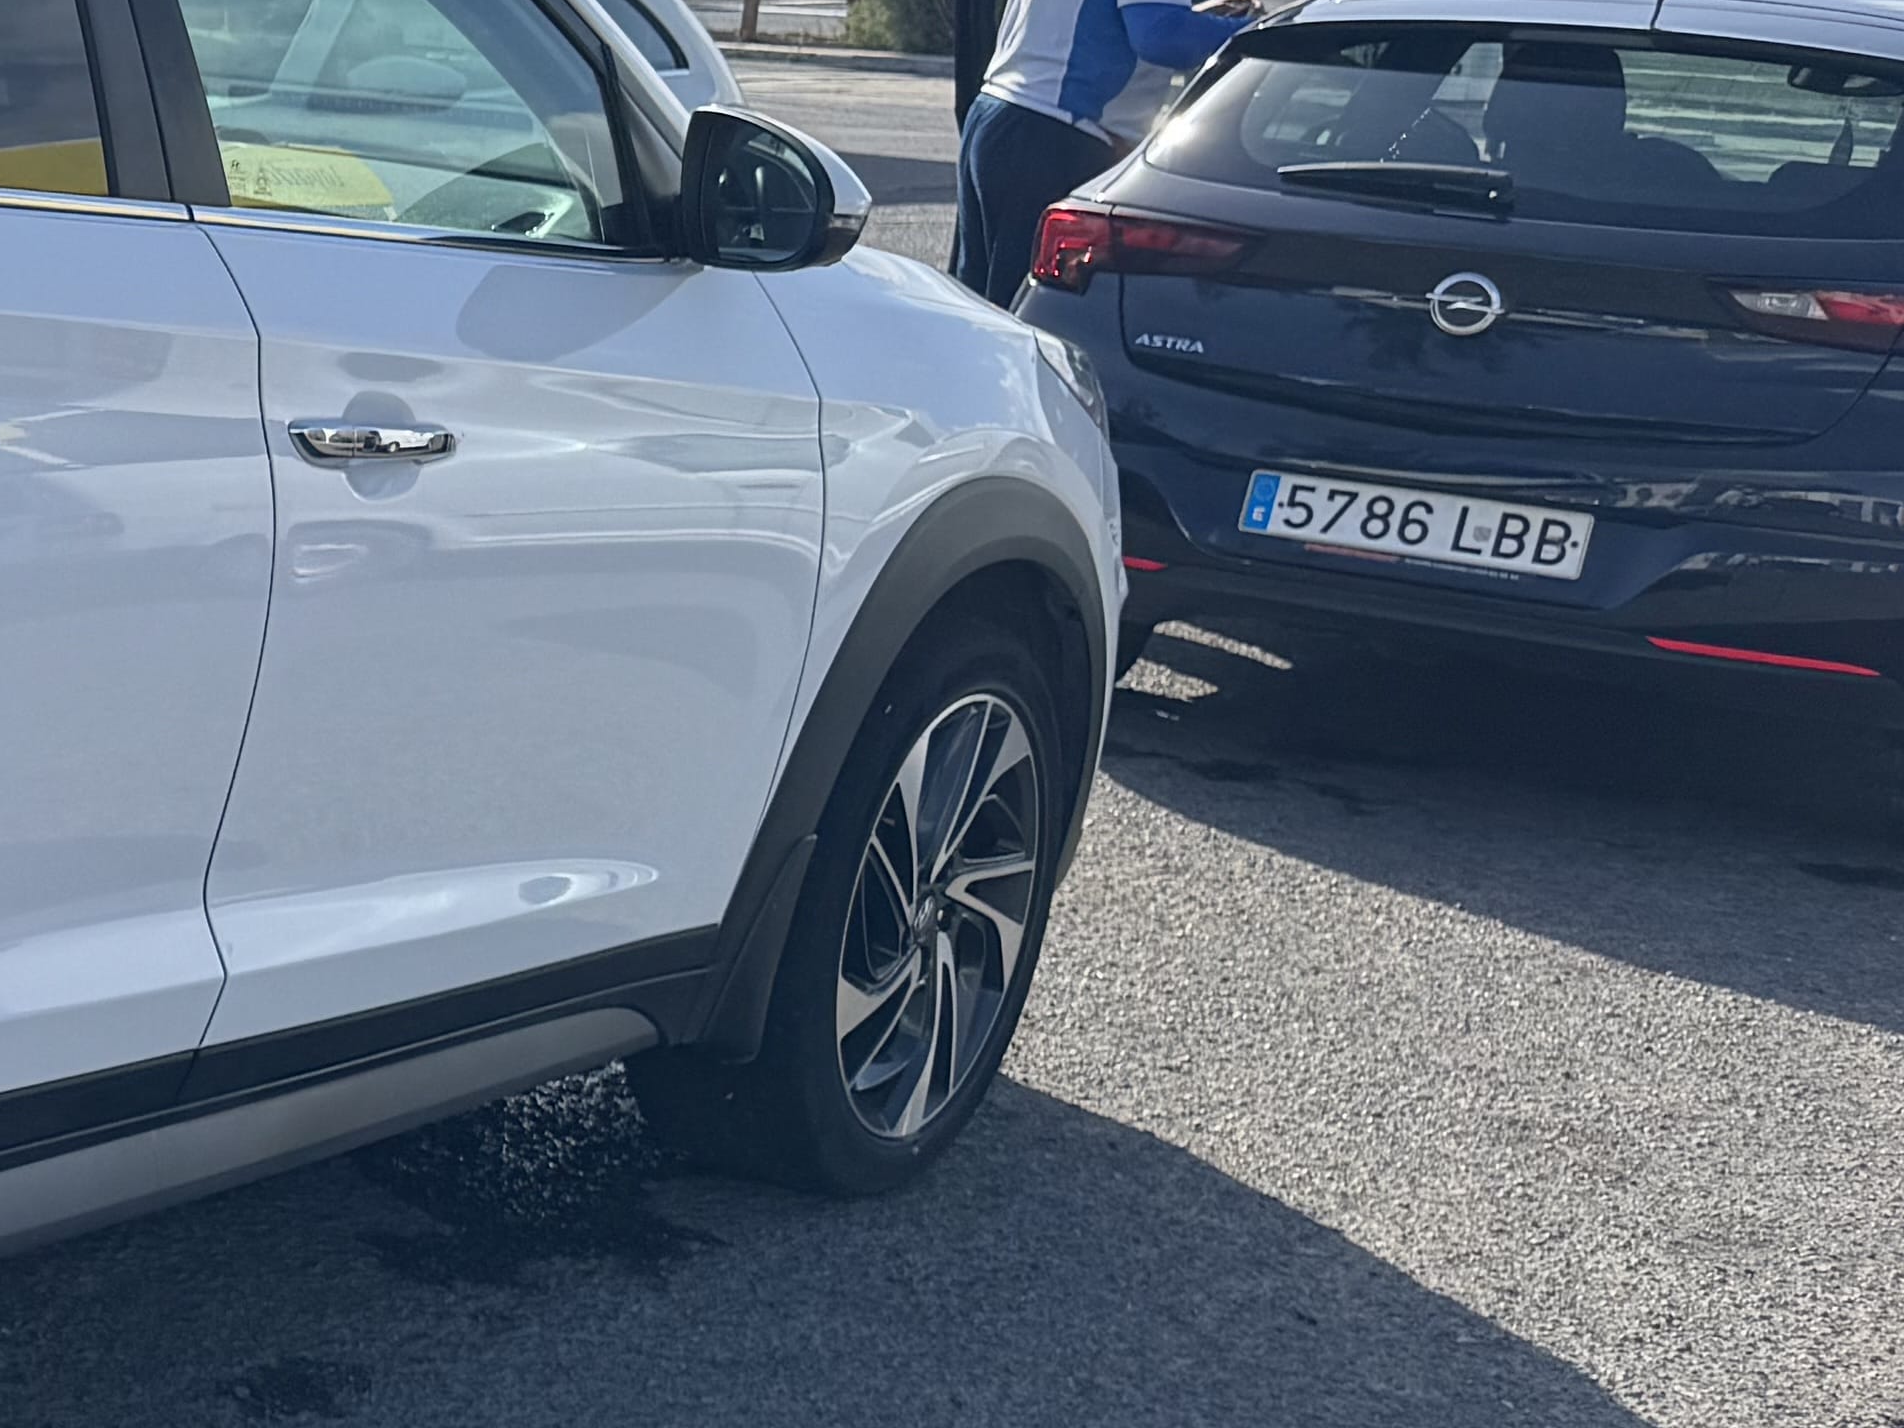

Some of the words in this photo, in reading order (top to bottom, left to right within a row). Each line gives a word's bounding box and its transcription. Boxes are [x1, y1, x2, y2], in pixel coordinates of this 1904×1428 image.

[1135, 333, 1204, 354] ASTRA
[1282, 484, 1434, 546] 5786
[1450, 505, 1572, 566] LBB
